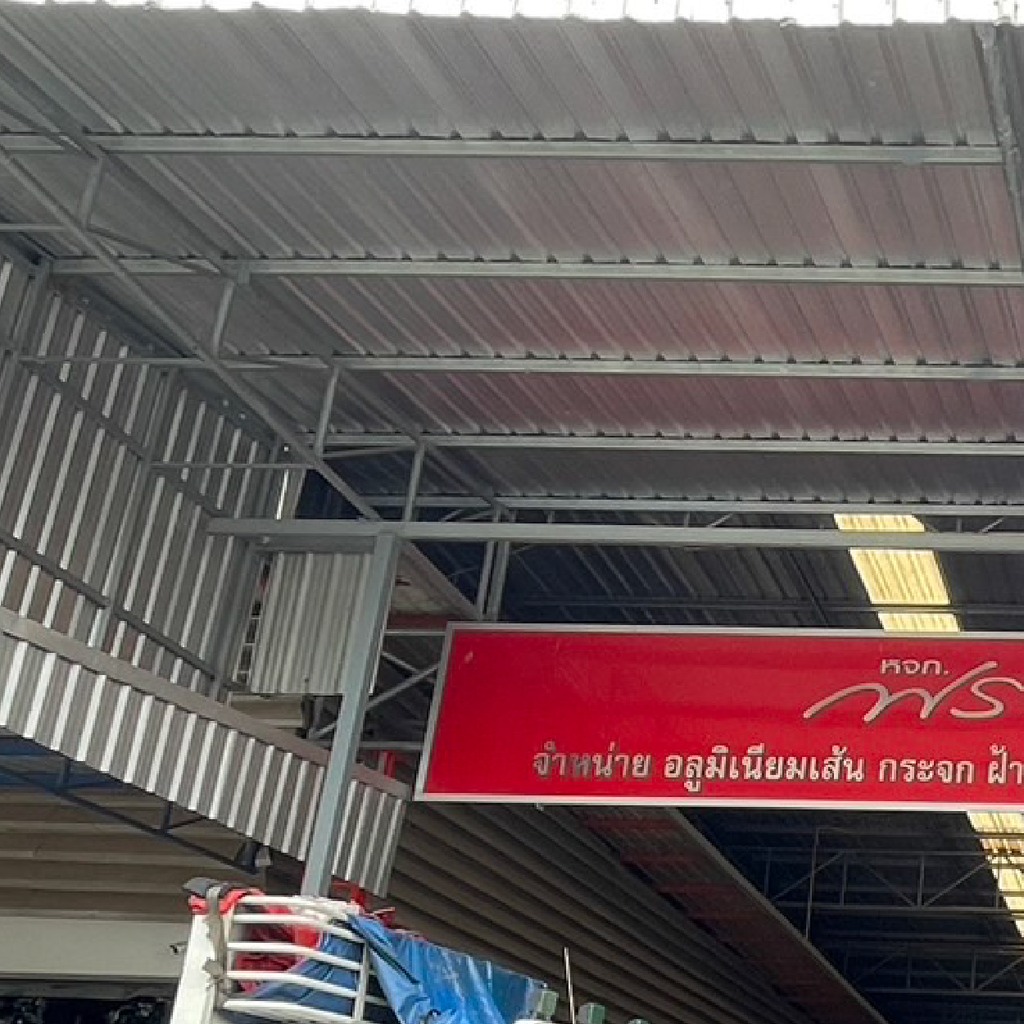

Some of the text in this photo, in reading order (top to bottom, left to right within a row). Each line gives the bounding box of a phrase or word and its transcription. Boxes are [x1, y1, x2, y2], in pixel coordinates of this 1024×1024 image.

[881, 658, 949, 676] หจก.
[533, 741, 651, 779] จำหน่าย
[664, 743, 867, 793] อลูมิเนียมเส้น
[878, 758, 975, 784] กระจก
